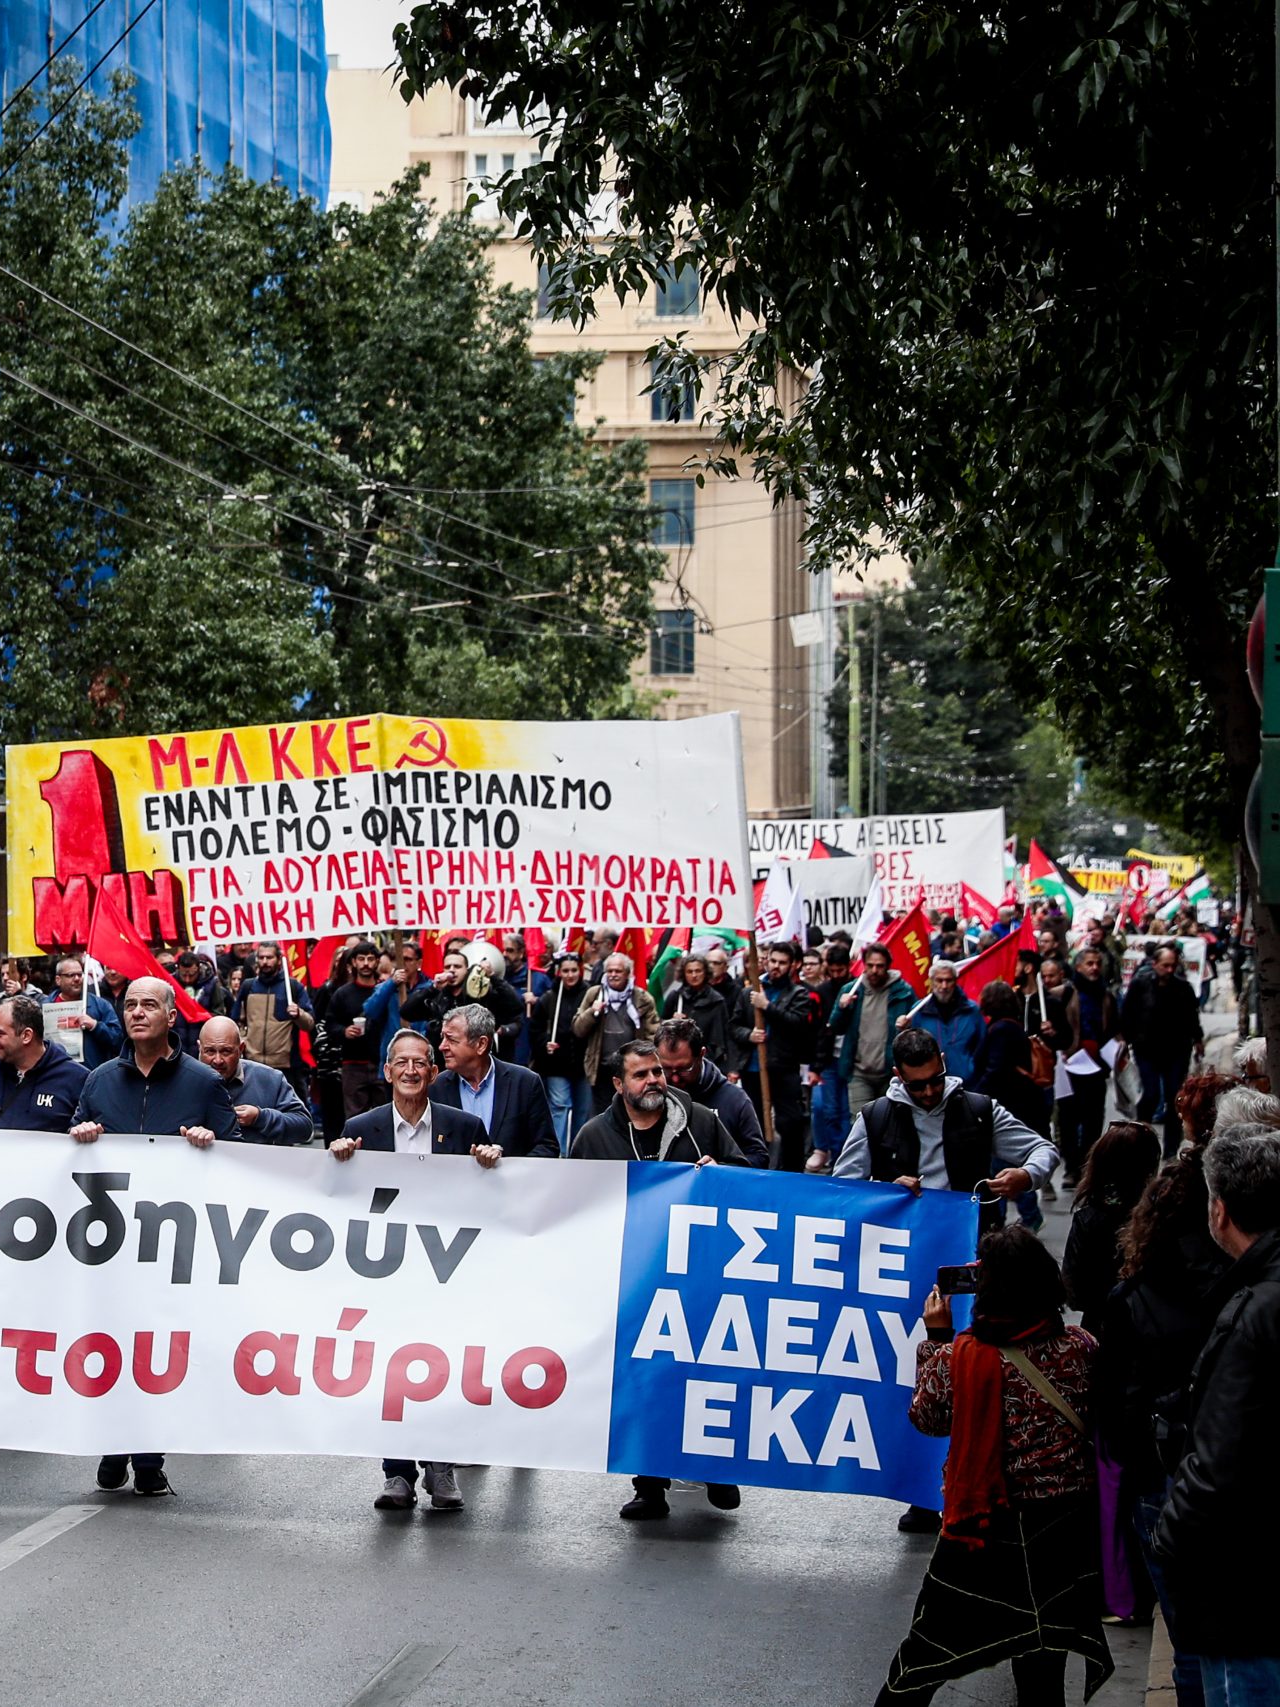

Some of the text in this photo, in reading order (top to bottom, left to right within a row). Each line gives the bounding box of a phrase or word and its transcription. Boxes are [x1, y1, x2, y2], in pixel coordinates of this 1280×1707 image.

[148, 719, 374, 790] Μ-Λ ΚΚΕ
[39, 749, 127, 880] 1
[145, 771, 612, 831] ΕΝΑΝΤΙΑ ΣΕ ΙΜΠΕΡΙΑΛΙΣΜΟ
[171, 815, 331, 863] ΠΟΛΕΜΟ
[361, 806, 520, 850] ΦΑΣΙΣΜΟ
[750, 822, 843, 851] ΔΟΥΛΕΙΕΣ
[188, 865, 243, 902] ΓΙΑ
[190, 898, 315, 941] ΕΘΝΙΚΗ
[666, 1204, 911, 1300] ΓΣΕΕ
[0, 1328, 191, 1399] του
[233, 1306, 568, 1423] αύριο
[630, 1288, 930, 1389] ΑΔΕΔΥ
[681, 1379, 882, 1471] ΕΚΑ
